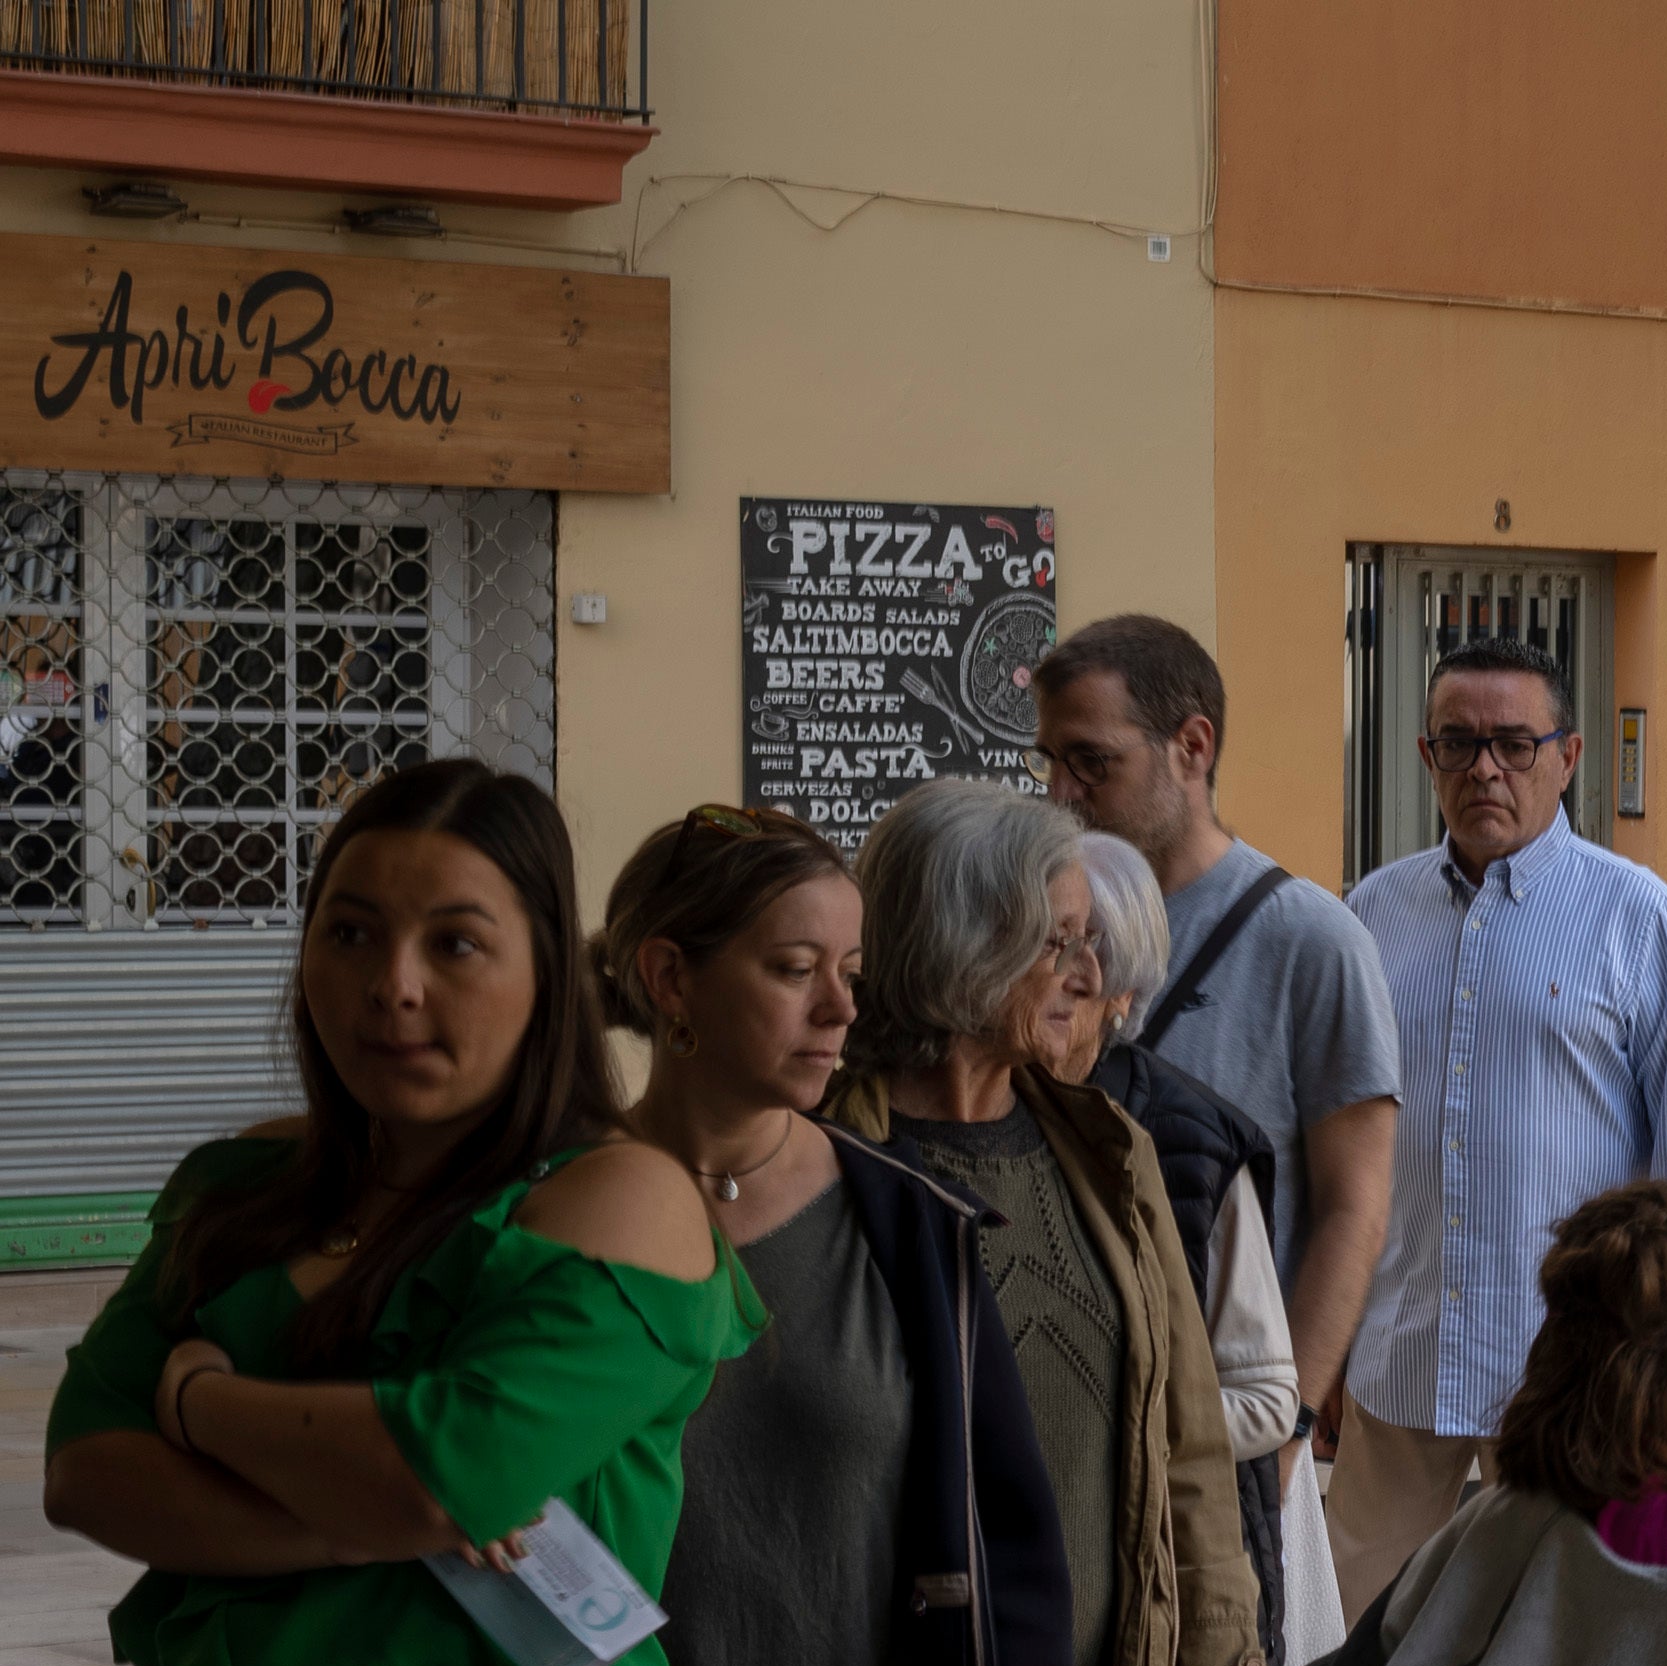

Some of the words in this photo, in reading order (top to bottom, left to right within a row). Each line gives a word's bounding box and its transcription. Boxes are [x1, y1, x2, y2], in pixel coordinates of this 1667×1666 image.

[34, 271, 237, 424] Apri
[238, 269, 461, 424] Bocca
[199, 419, 250, 434] ITALIAN
[252, 427, 329, 447] RESTAURANT
[787, 503, 841, 518] ITALIAN
[845, 505, 884, 519] FOOD
[1494, 499, 1511, 534] 8
[788, 518, 983, 581] PIZZA
[979, 541, 1006, 563] TO
[787, 576, 850, 596] TAKE
[858, 577, 921, 598] AWAY
[781, 599, 875, 623] BOARDS
[885, 608, 960, 625] SALADS
[752, 623, 953, 658] SALTIMBOCCA
[765, 657, 886, 691] BEERS
[762, 690, 808, 706] COFFEE
[796, 720, 923, 743] ENSALADAS
[751, 742, 795, 756] DRINKS
[760, 758, 794, 771] SPRITZ
[800, 746, 936, 779] PASTA
[760, 780, 853, 797] CERVEZAS
[808, 798, 897, 823] DOLC
